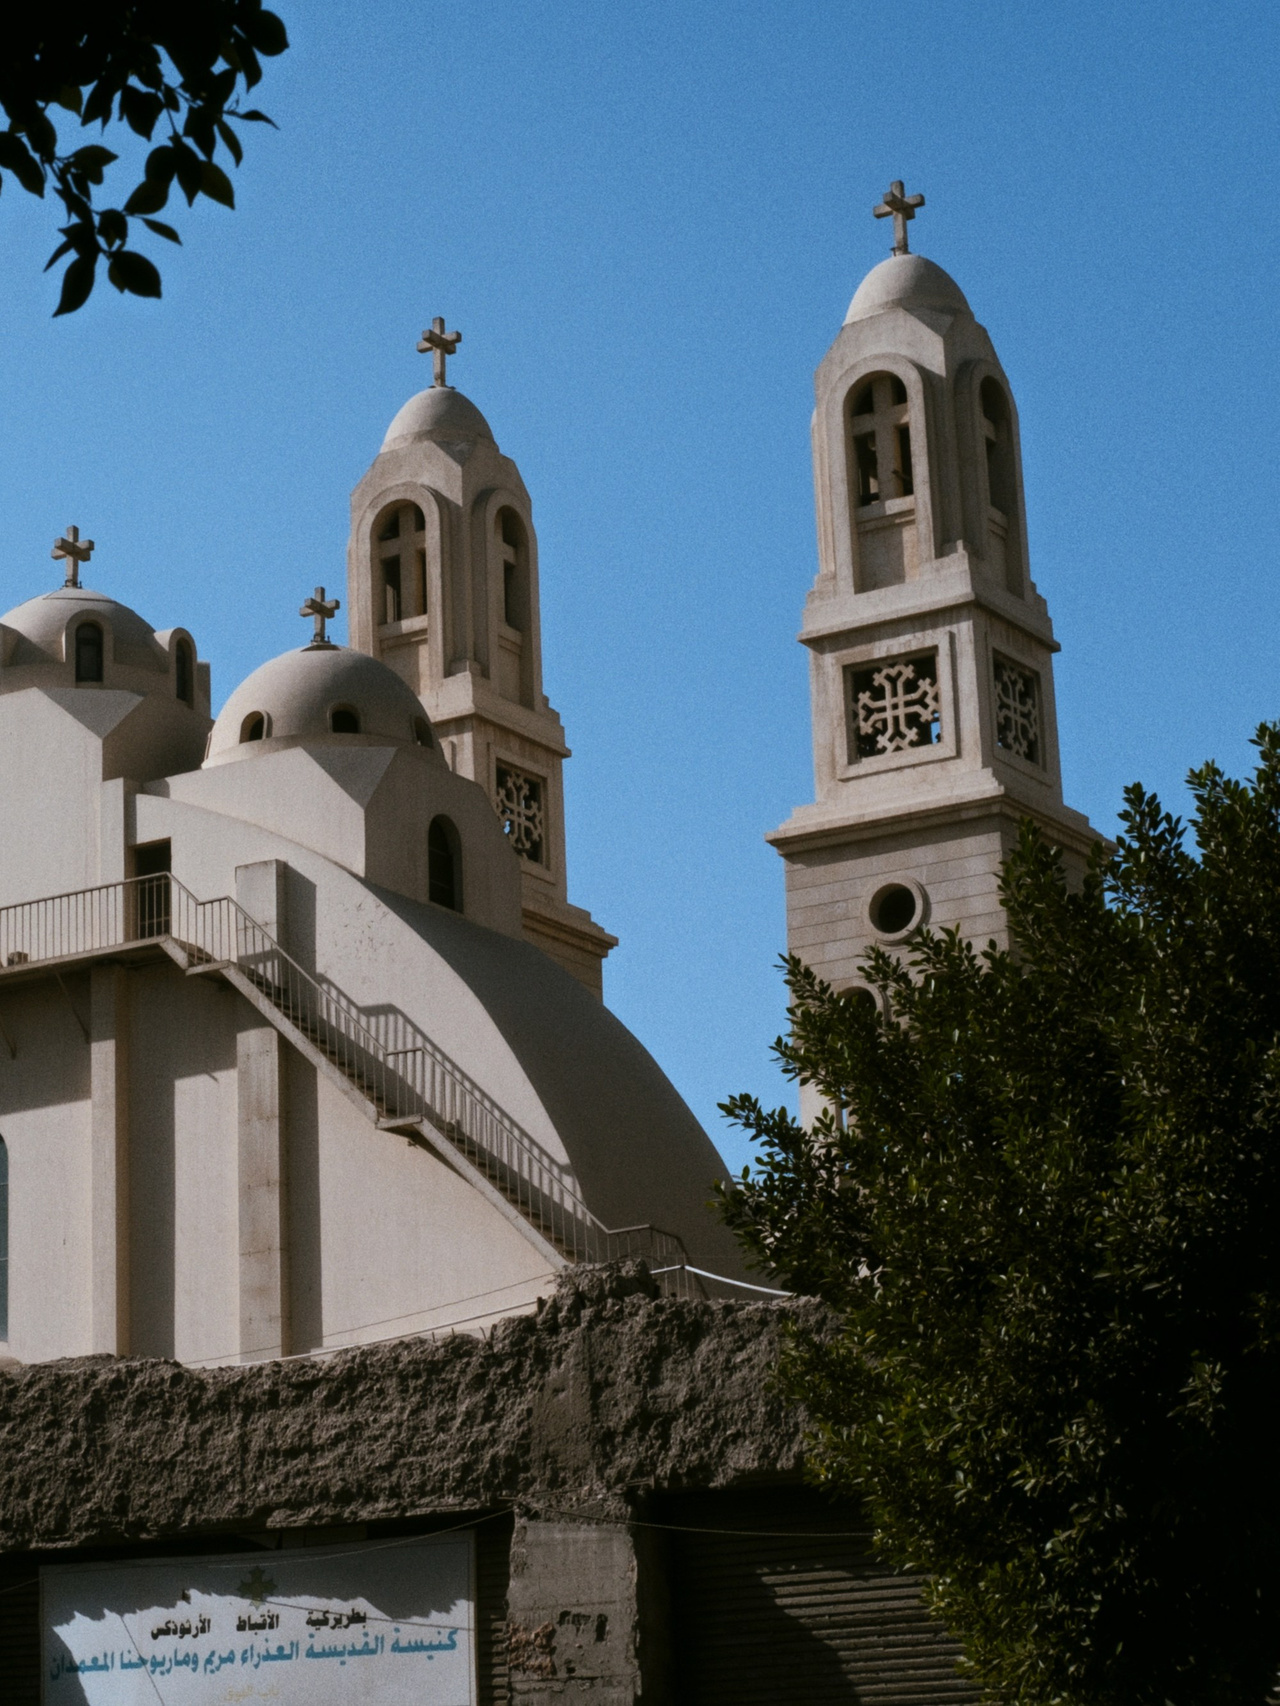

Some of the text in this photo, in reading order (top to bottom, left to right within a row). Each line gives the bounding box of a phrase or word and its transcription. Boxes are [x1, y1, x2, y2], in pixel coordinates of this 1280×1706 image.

[151, 1608, 366, 1640] بطريركية الأقباط الأرثوذكس
[241, 1637, 299, 1669] العذراء
[305, 1631, 385, 1666] القديسة
[391, 1627, 458, 1660] كنيسة
[49, 1652, 114, 1681] المعمدان
[203, 1648, 235, 1675] مريم
